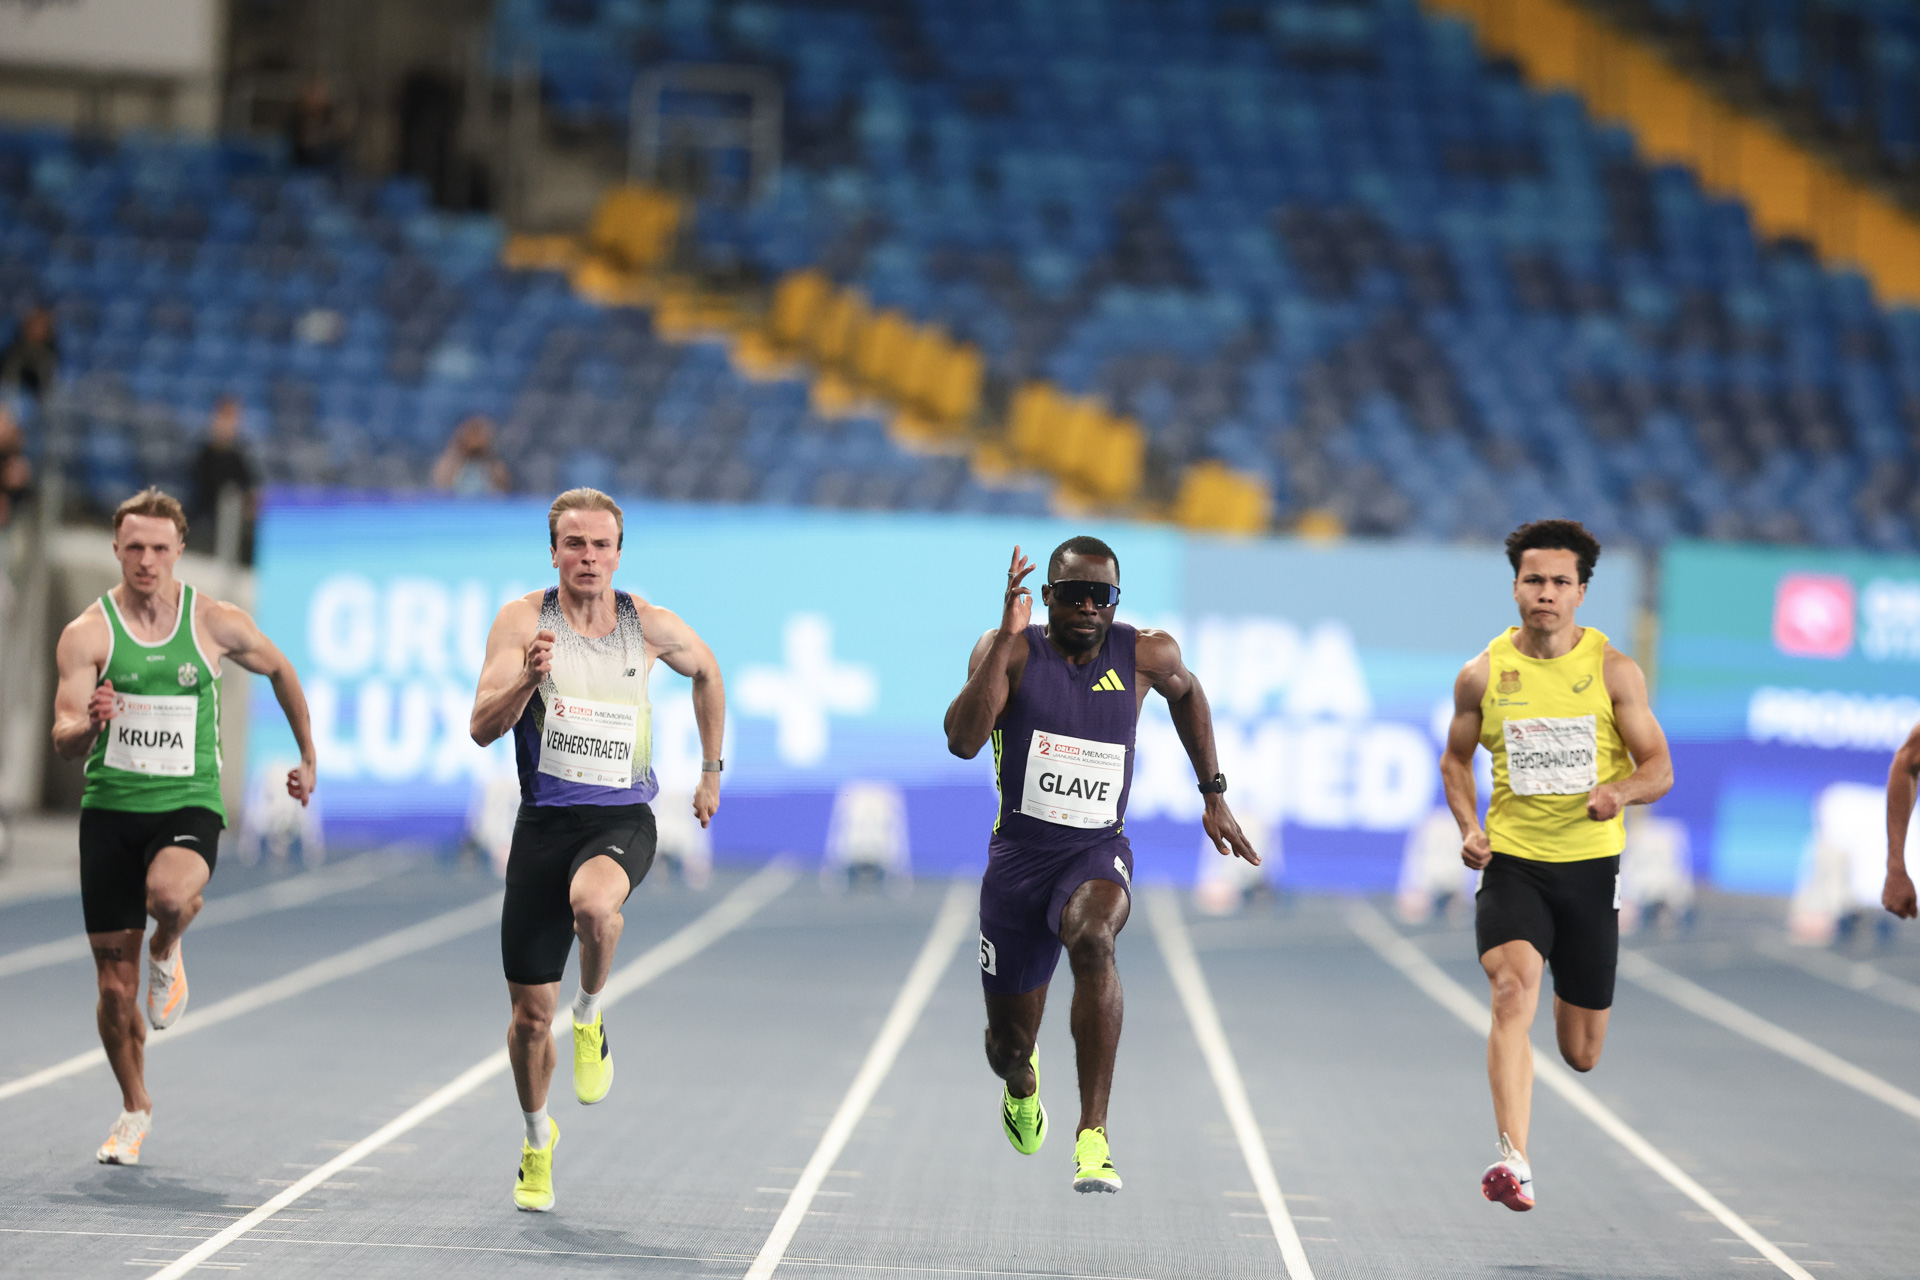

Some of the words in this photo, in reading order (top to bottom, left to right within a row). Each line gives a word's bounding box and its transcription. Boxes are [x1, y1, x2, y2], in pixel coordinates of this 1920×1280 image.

[118, 725, 184, 749] KRUPA
[546, 728, 631, 760] VERHERSTRAETEN
[1055, 745, 1080, 754] ORLEN
[1038, 772, 1110, 802] GLAVE
[980, 939, 990, 969] 5
